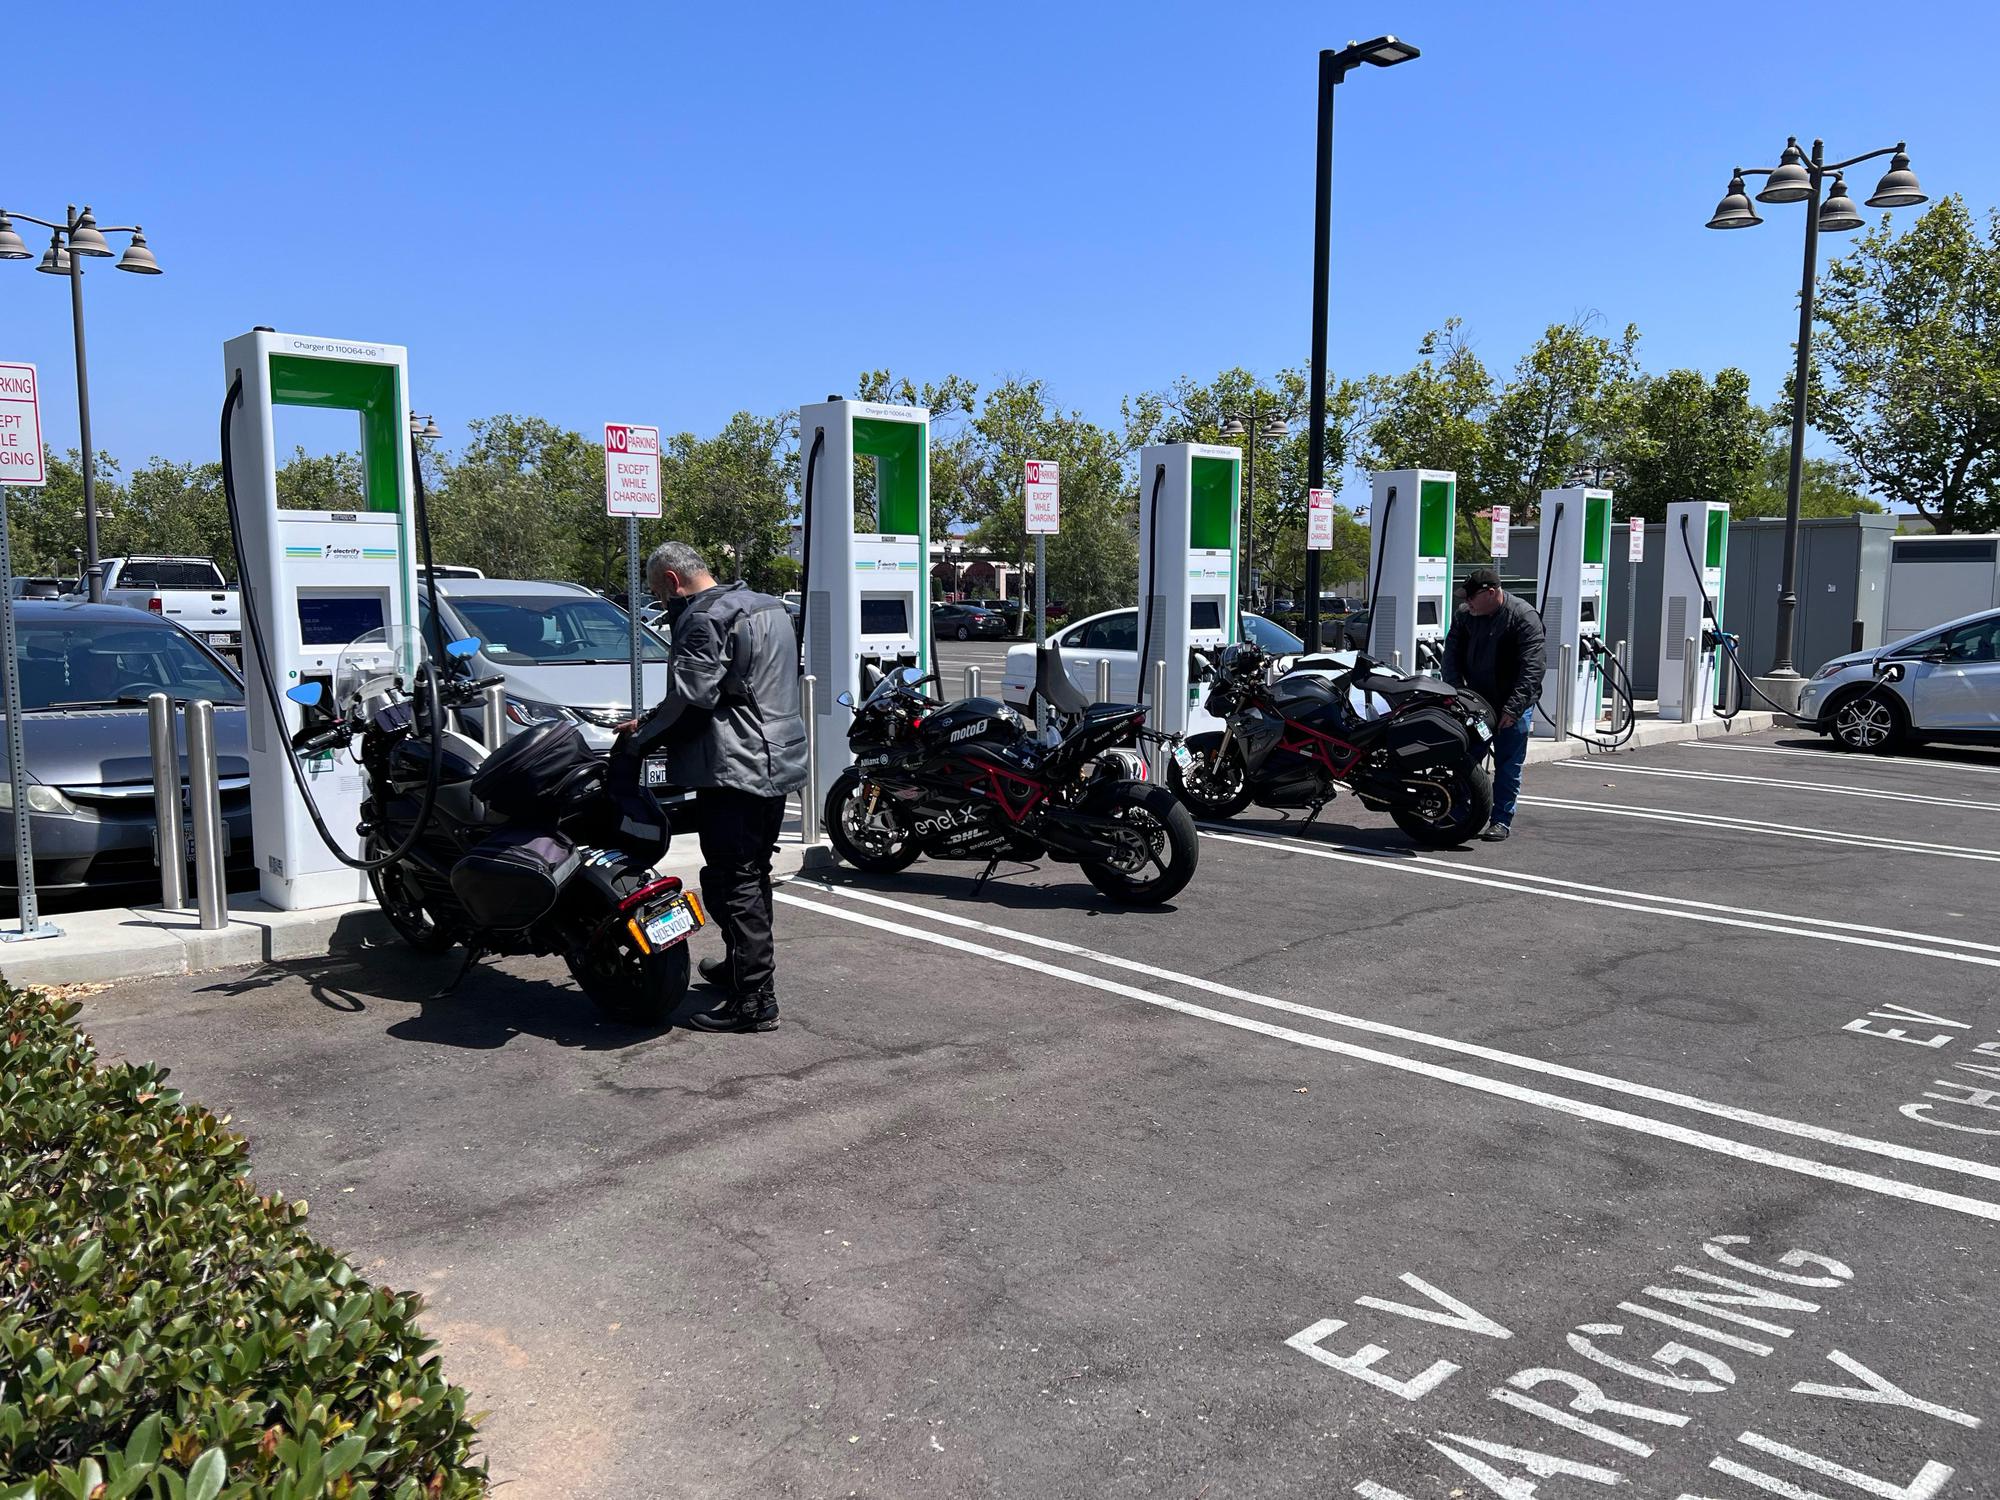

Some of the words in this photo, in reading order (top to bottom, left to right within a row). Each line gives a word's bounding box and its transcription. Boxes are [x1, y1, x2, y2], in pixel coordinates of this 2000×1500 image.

[293, 340, 324, 352] Charger
[325, 344, 334, 352] ID
[335, 345, 377, 357] 110064-06
[607, 429, 626, 450] NO
[627, 436, 656, 449] PARKING
[617, 463, 650, 475] EXCEPT
[1027, 465, 1039, 481] NO
[621, 478, 647, 489] WHILE
[613, 491, 656, 503] CHARGING
[1033, 492, 1053, 501] EXCEPT
[1034, 503, 1051, 512] WHILE
[1030, 514, 1056, 523] CHARGING
[333, 548, 360, 556] electrify
[914, 809, 958, 835] enel
[950, 828, 983, 844] DHL
[1841, 1002, 1973, 1049] EV
[1283, 1272, 1513, 1401] EV
